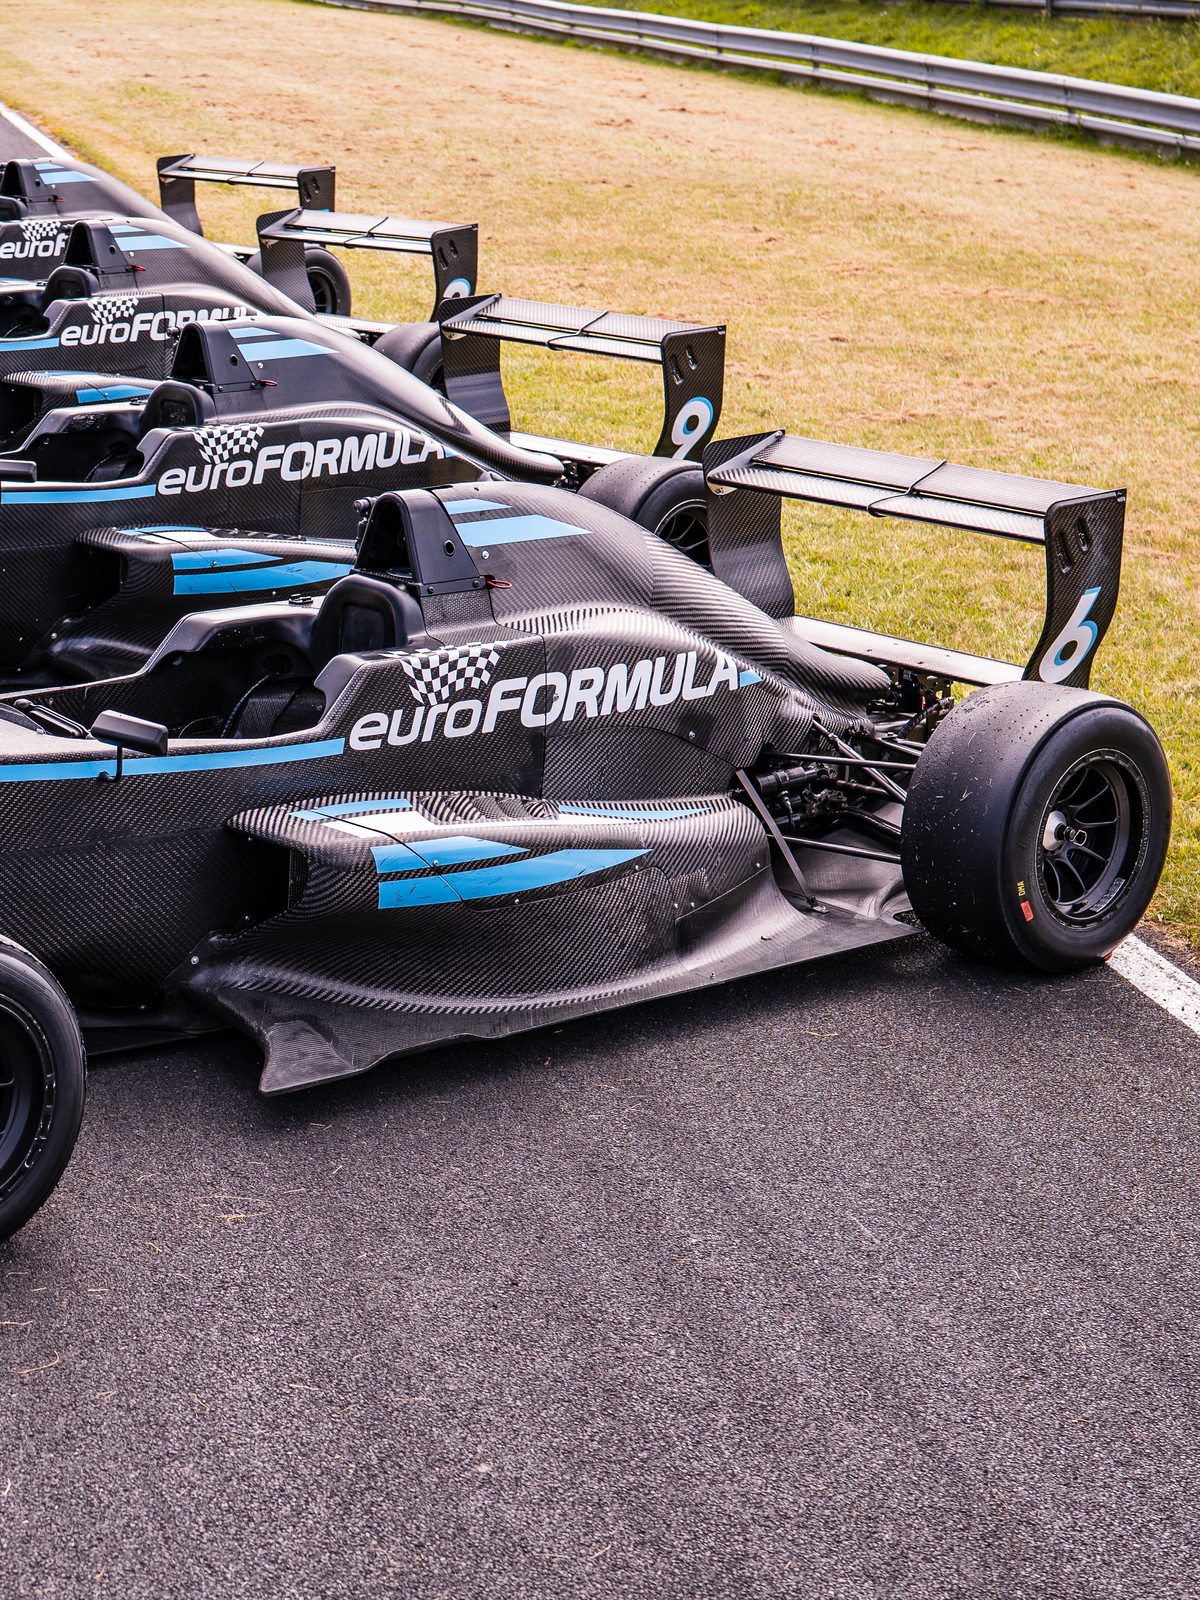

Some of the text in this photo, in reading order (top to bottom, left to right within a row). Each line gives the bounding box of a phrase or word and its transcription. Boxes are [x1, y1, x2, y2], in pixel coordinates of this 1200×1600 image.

[672, 396, 715, 460] 9
[157, 430, 446, 496] euroFORMULA
[1039, 586, 1102, 684] 6
[350, 649, 741, 751] euroFORMULA
[1017, 880, 1026, 897] DMA
